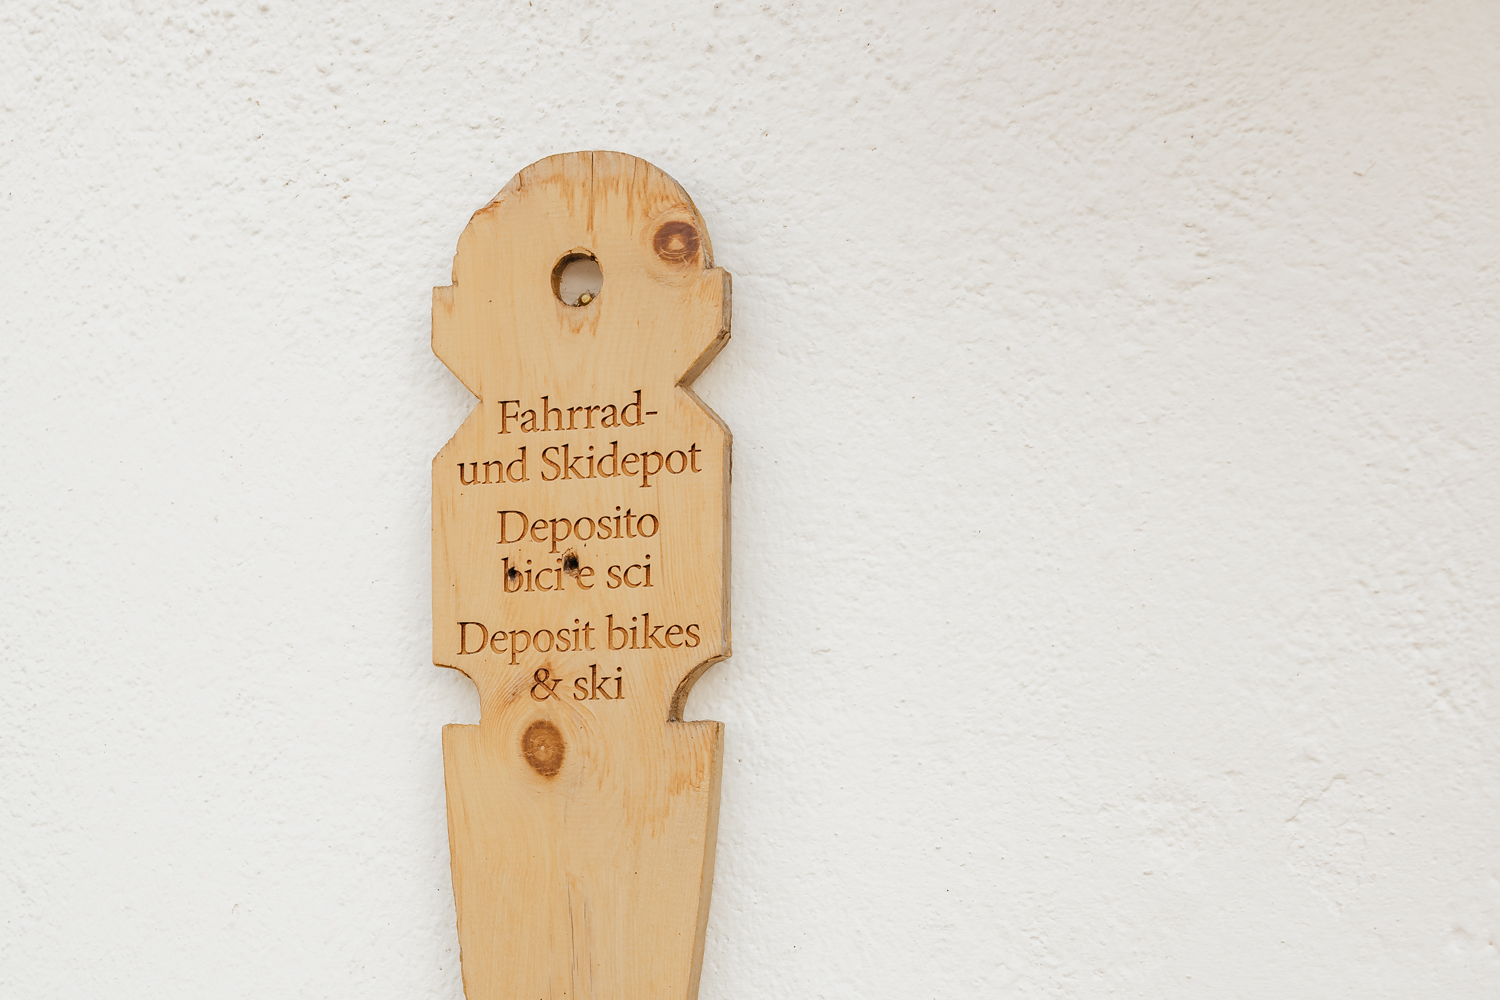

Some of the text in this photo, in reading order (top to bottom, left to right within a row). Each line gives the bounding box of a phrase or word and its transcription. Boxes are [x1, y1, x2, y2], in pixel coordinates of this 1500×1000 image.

[497, 389, 658, 435] Fahrrad-
[457, 441, 702, 488] und Skidepot
[496, 505, 659, 554] Deposito
[501, 554, 654, 593] bici e sci
[457, 612, 700, 665] Deposit bikes
[530, 663, 625, 702] & ski
